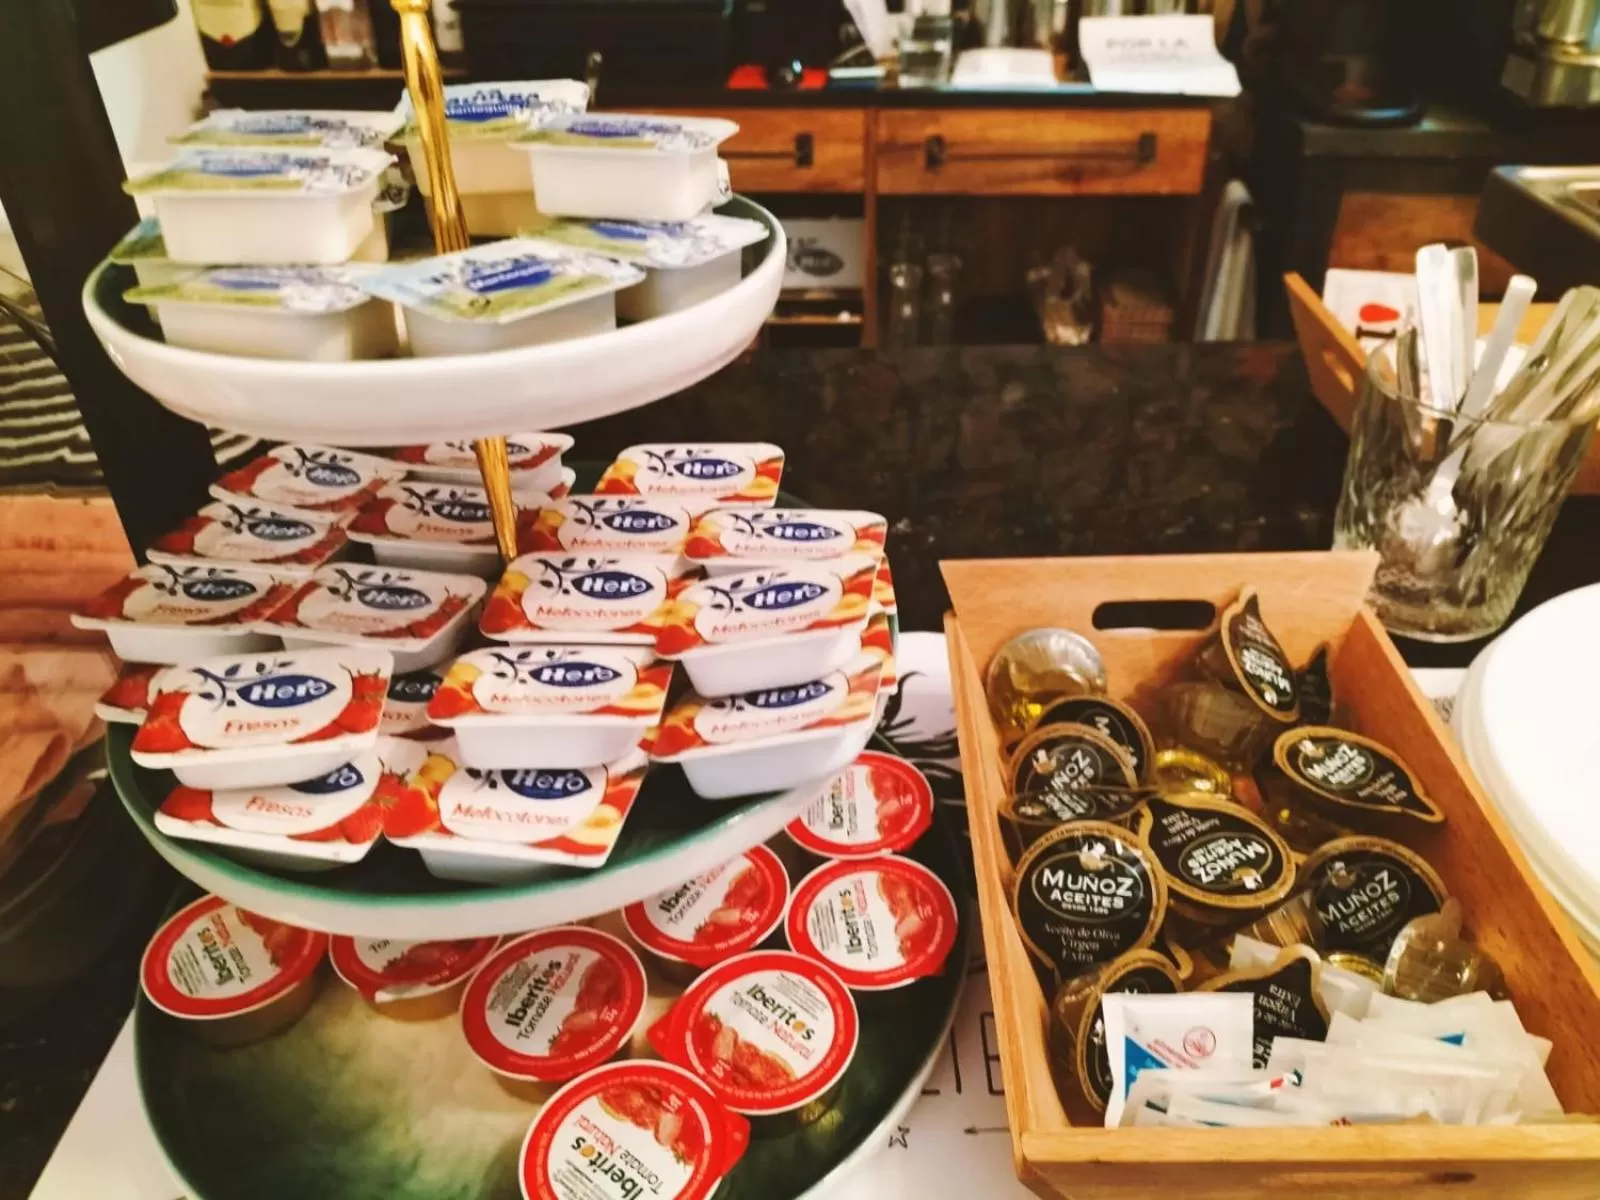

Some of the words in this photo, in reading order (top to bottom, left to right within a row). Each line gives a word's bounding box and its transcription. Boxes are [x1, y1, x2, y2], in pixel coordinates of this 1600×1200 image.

[683, 461, 739, 475] Hero
[611, 515, 672, 530] Hero
[772, 525, 836, 540] Hero
[580, 577, 648, 595] Hero
[753, 583, 822, 608] Hero
[538, 664, 616, 683] Hero
[249, 677, 330, 701] Hero
[756, 682, 827, 707] Hero
[511, 769, 586, 792] Hero
[1042, 866, 1135, 899] MUÑOZ
[1050, 887, 1126, 910] ACEITES
[1317, 869, 1398, 927] MUÑOZ
[1338, 890, 1401, 934] ACEITES
[1060, 934, 1101, 952] Virgen
[1076, 927, 1091, 938] de
[504, 958, 563, 1029] Iberitos
[745, 982, 816, 1042] Iberitos
[770, 1020, 816, 1061] Natural
[571, 1113, 621, 1157] Natural
[570, 1136, 644, 1200] Iberitos
[618, 1148, 665, 1196] Tomate
